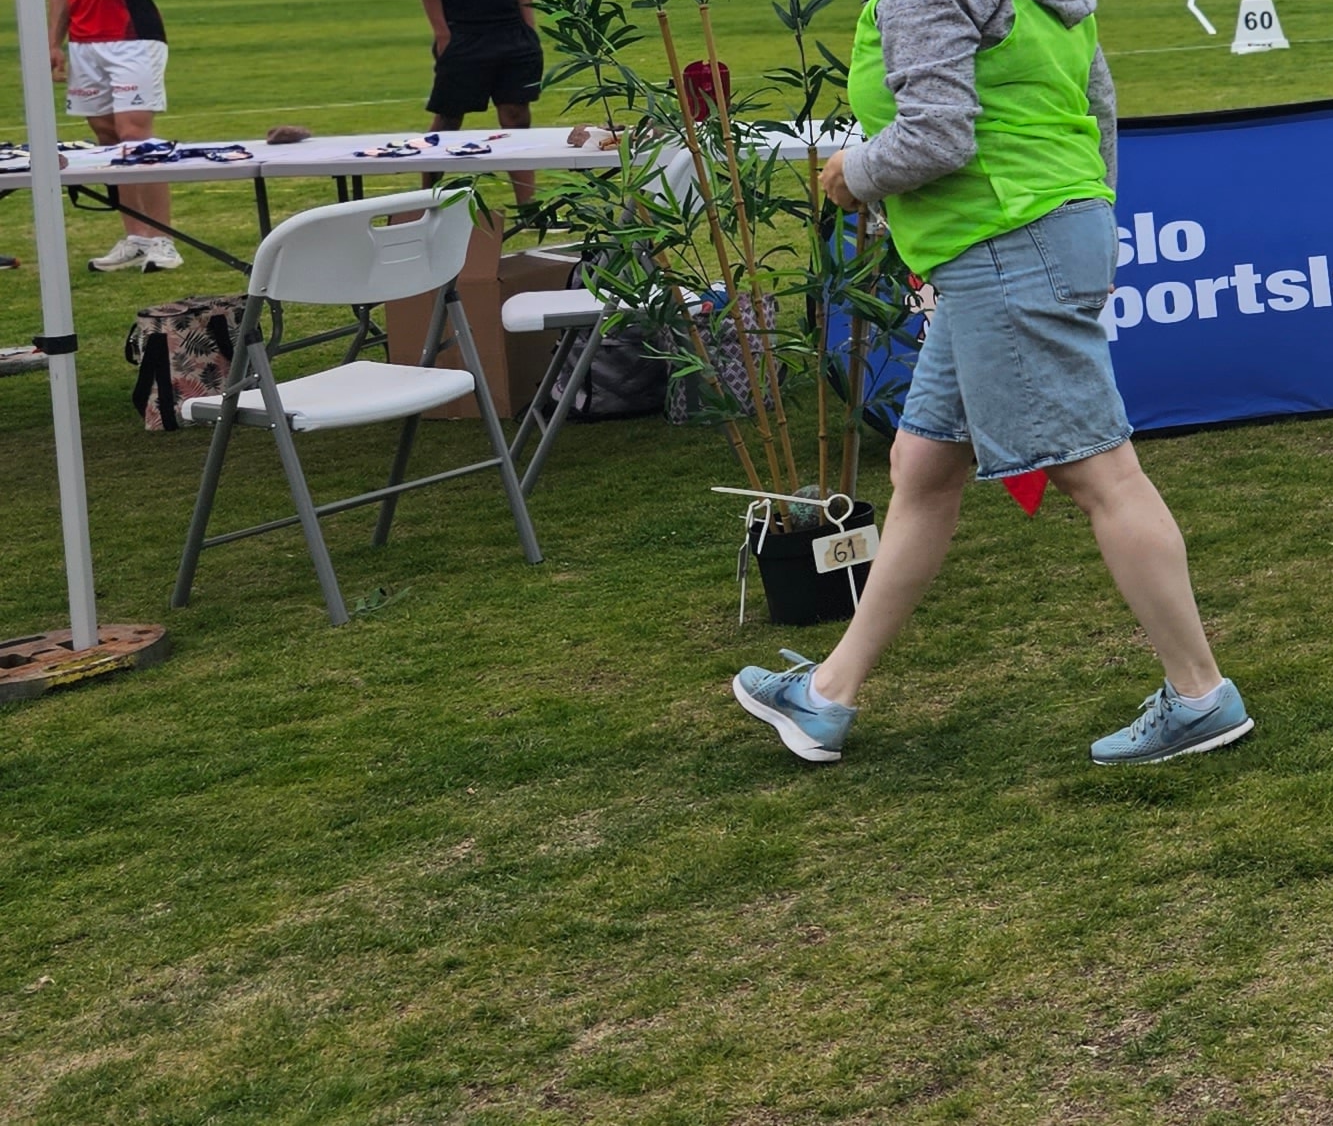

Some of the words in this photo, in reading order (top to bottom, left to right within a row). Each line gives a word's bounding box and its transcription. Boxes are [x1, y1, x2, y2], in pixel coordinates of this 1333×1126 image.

[1244, 11, 1273, 31] 60
[1116, 212, 1206, 268] slo
[834, 538, 856, 563] 61
